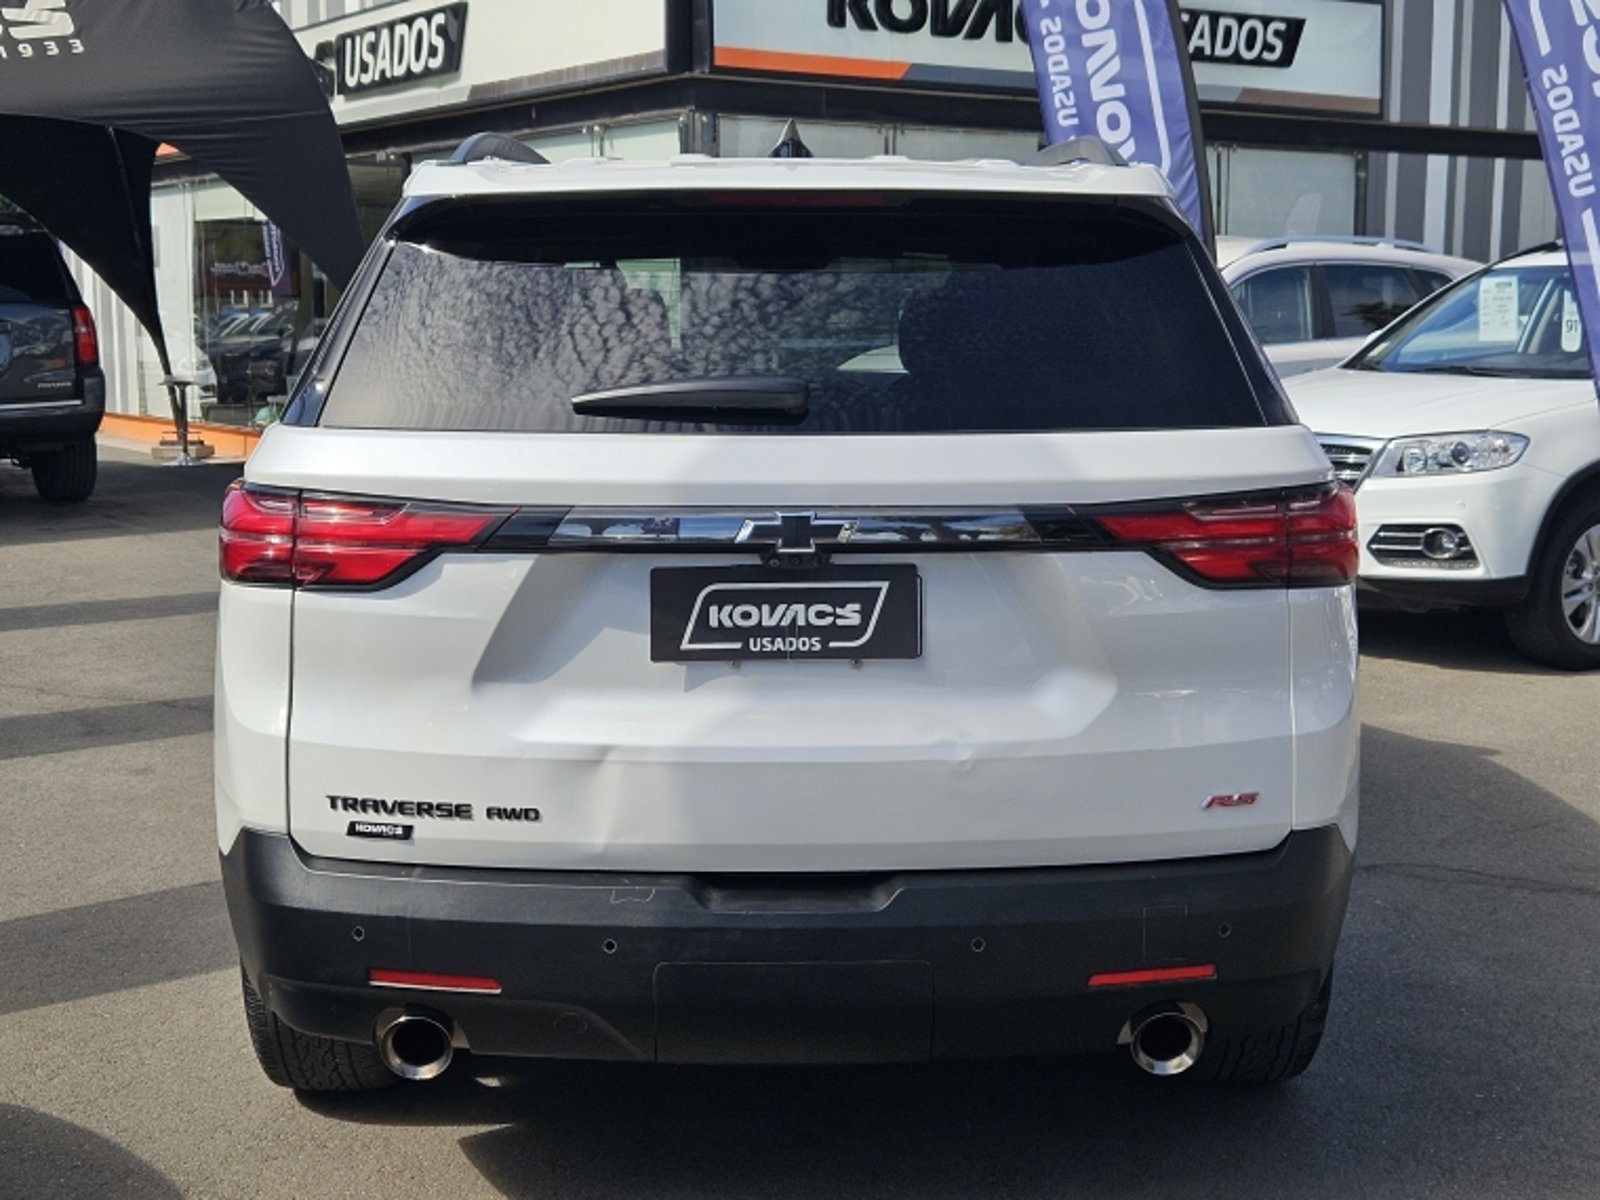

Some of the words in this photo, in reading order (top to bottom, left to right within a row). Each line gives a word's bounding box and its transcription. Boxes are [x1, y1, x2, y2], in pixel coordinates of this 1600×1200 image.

[826, 0, 1030, 45] KOVA
[344, 11, 446, 88] USADOS
[708, 602, 863, 628] KOVACS
[748, 636, 822, 652] USADOS
[326, 794, 475, 821] TRAVERSE
[485, 805, 543, 821] AWD
